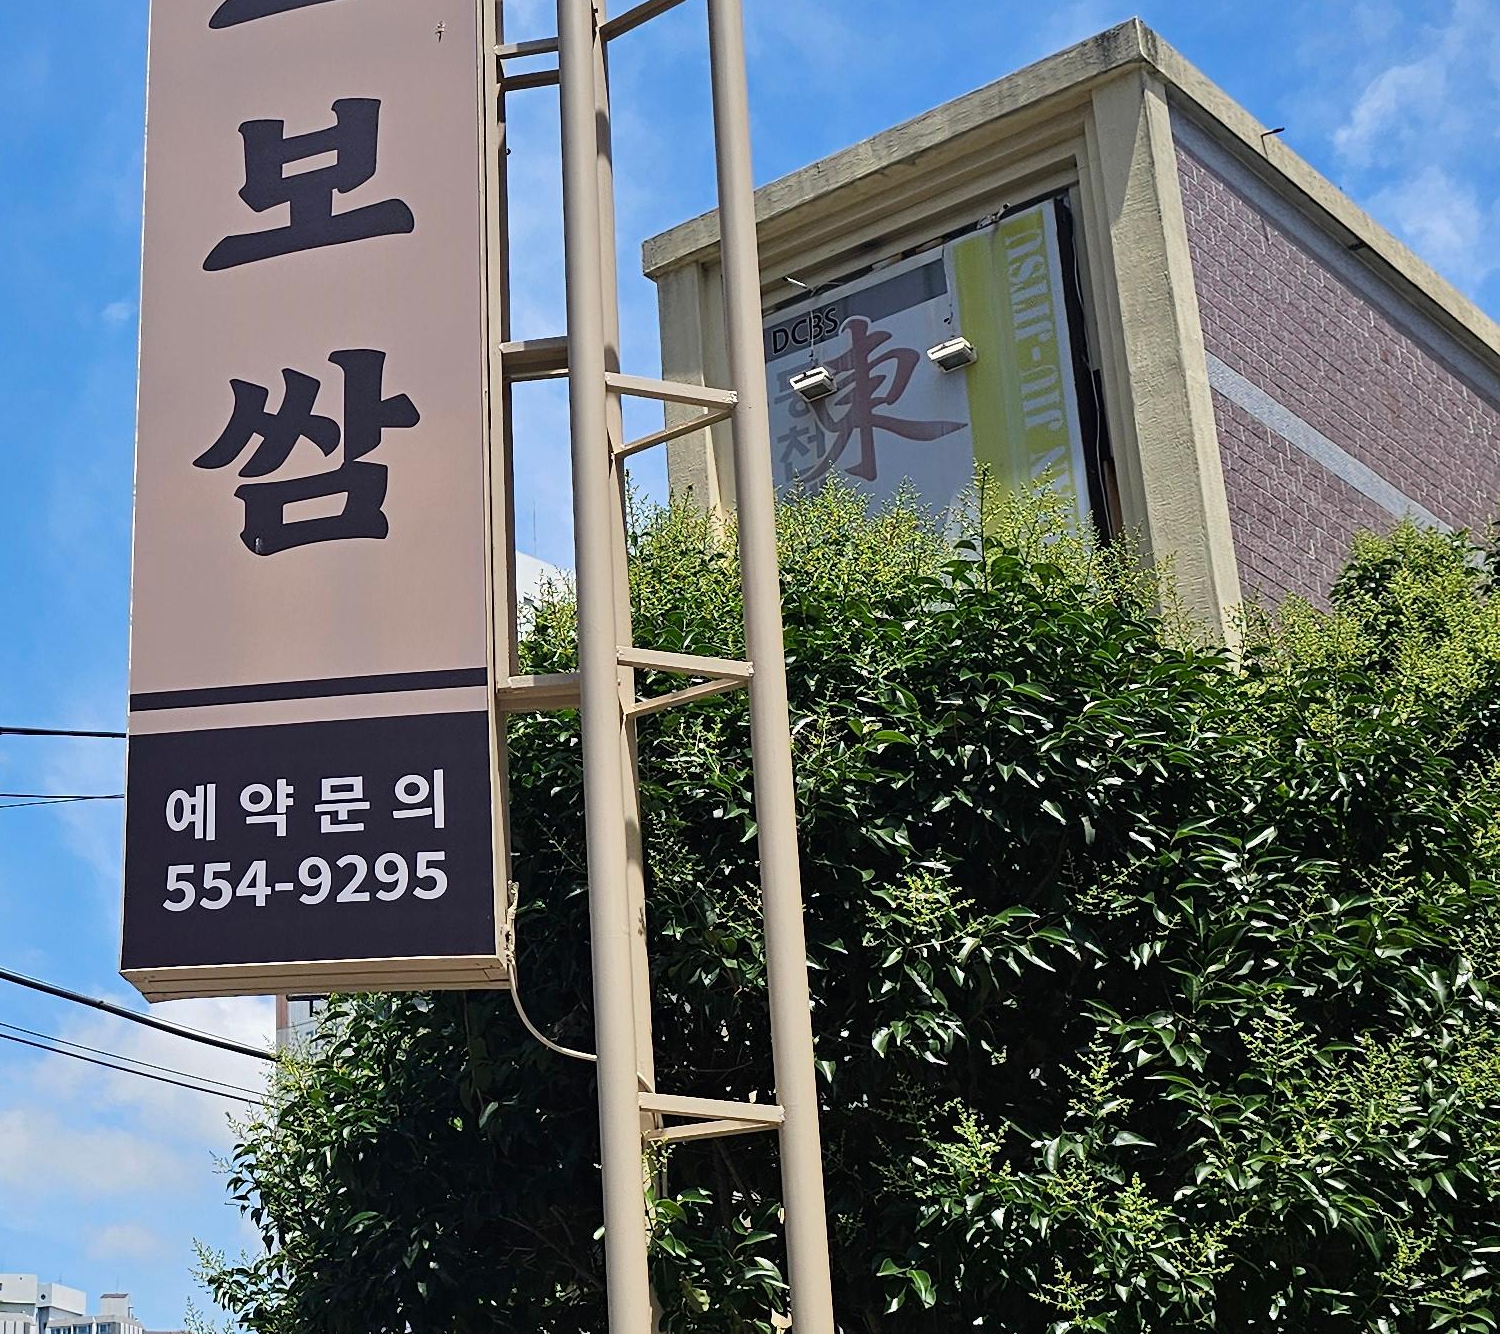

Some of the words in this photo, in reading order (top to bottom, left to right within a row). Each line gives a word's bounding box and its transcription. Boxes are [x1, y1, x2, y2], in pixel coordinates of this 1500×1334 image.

[772, 307, 840, 355] DCBS
[164, 768, 447, 841] 예약문의
[162, 850, 448, 912] 554-9295
